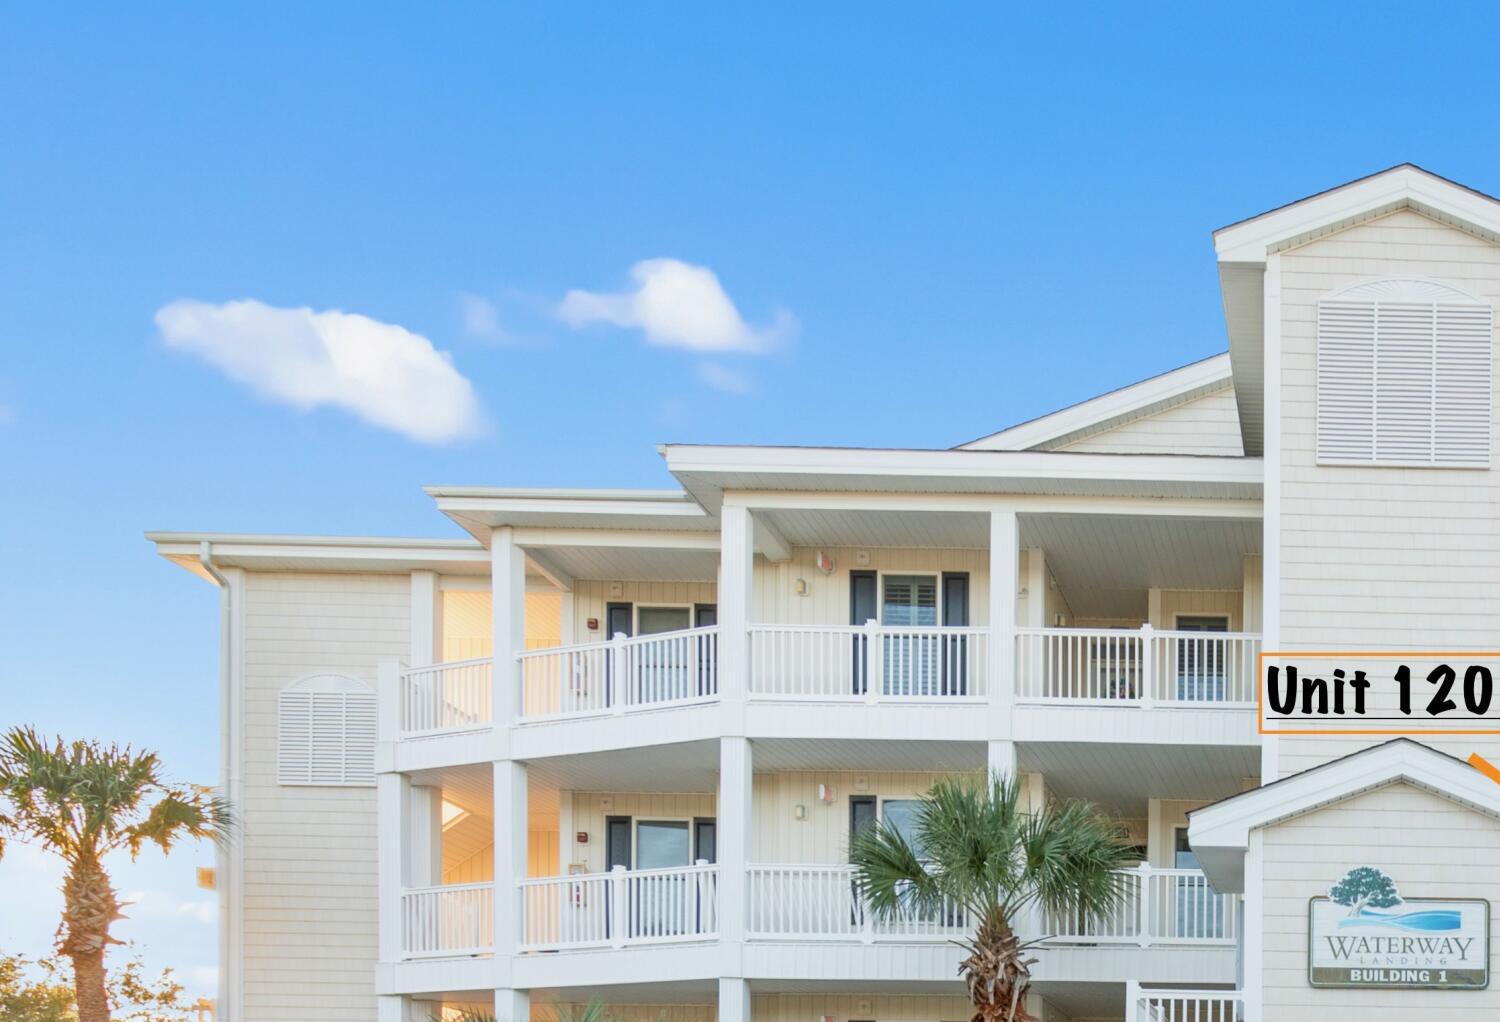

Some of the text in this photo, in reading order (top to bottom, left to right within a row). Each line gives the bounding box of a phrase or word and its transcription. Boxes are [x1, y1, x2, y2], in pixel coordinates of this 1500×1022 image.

[1323, 936, 1475, 961] WATERWAY
[1359, 957, 1448, 966] LANDING
[1350, 969, 1448, 983] BUILDING 1
